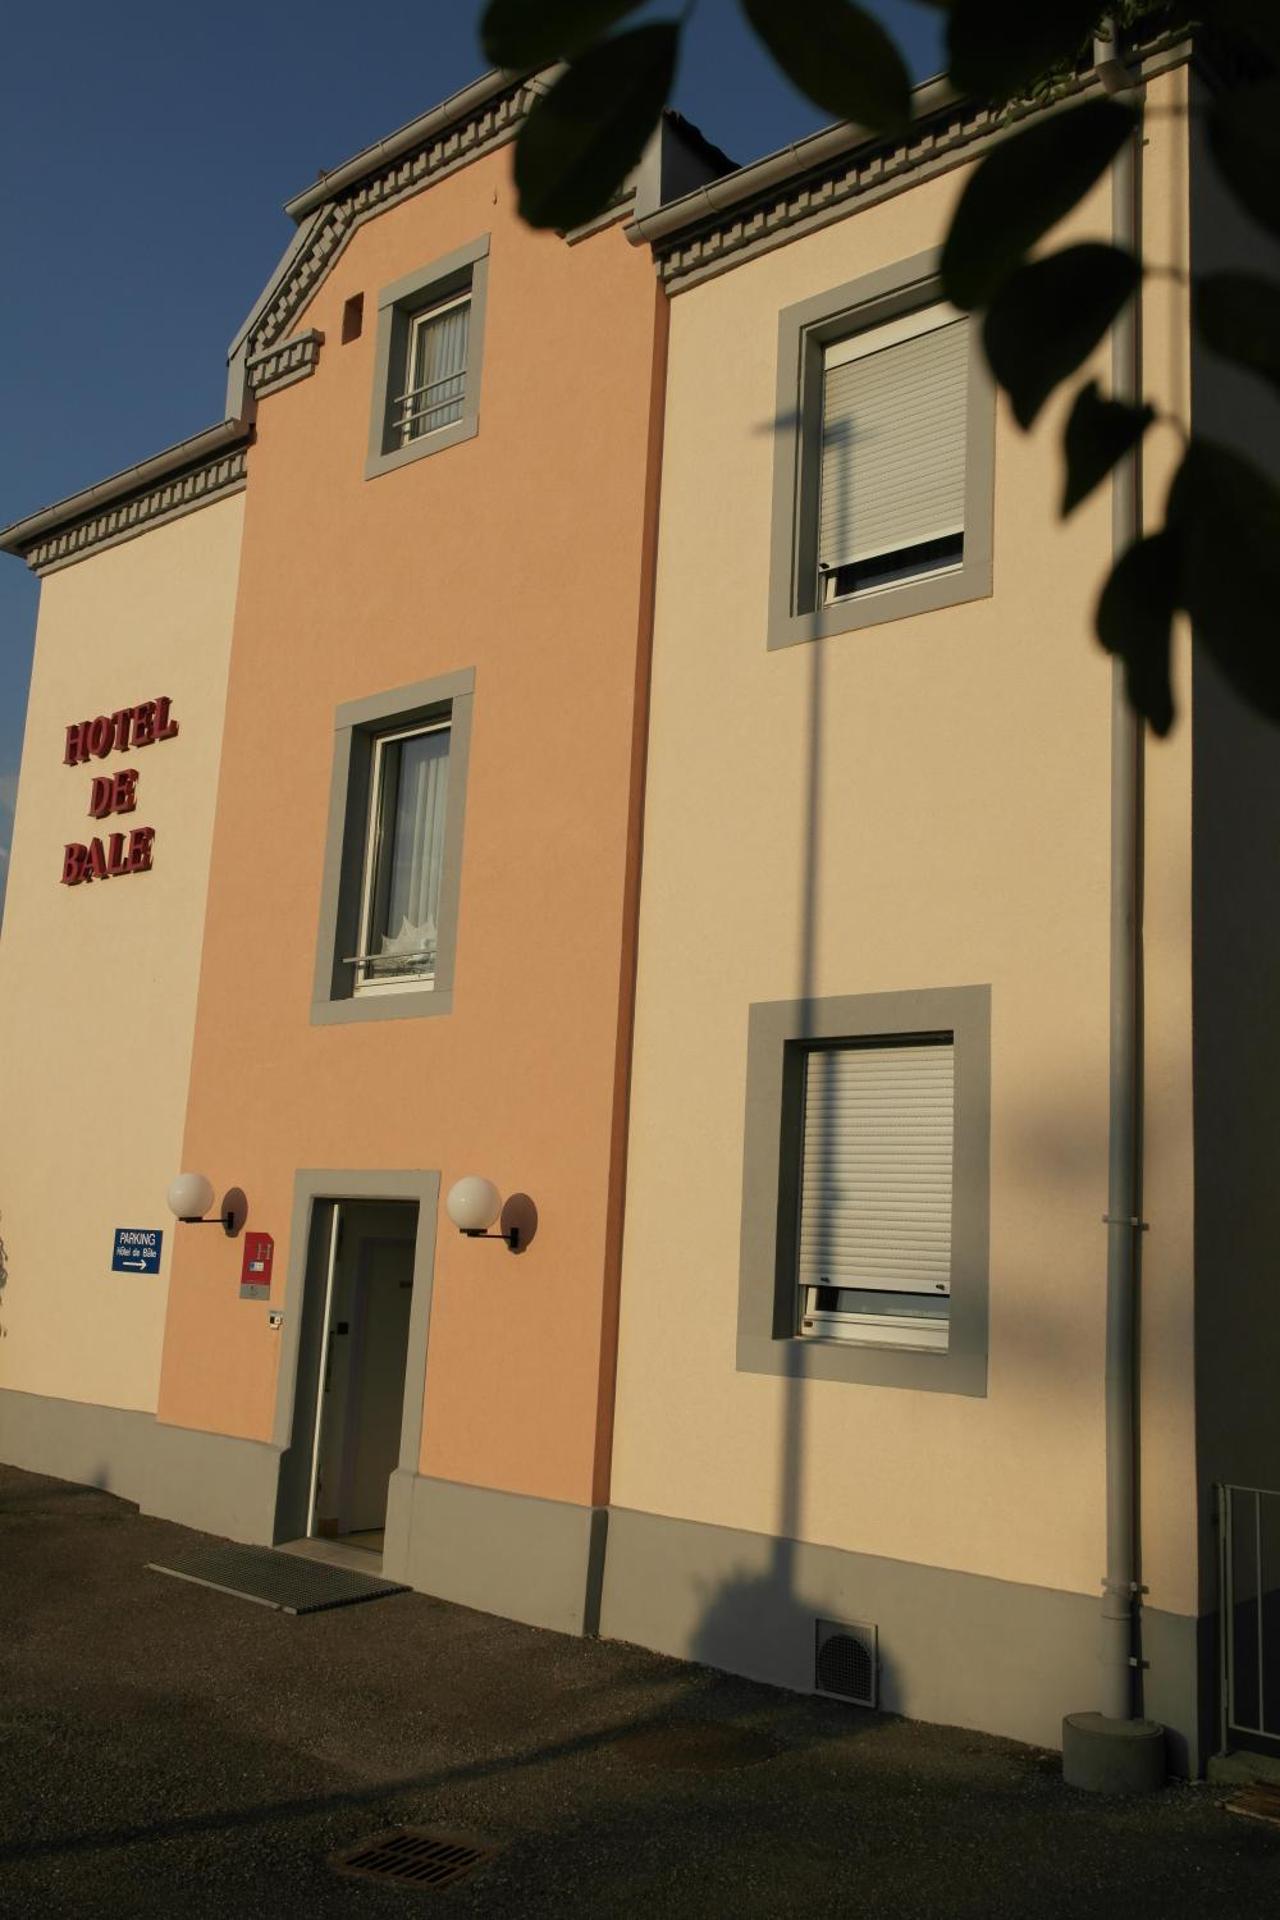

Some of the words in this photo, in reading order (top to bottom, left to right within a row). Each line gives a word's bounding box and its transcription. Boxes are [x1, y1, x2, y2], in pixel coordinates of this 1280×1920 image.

[63, 696, 178, 766] HOTEL
[88, 768, 139, 819] DE
[60, 827, 155, 886] BALE
[120, 1232, 156, 1246] PARKING
[132, 1248, 140, 1257] de
